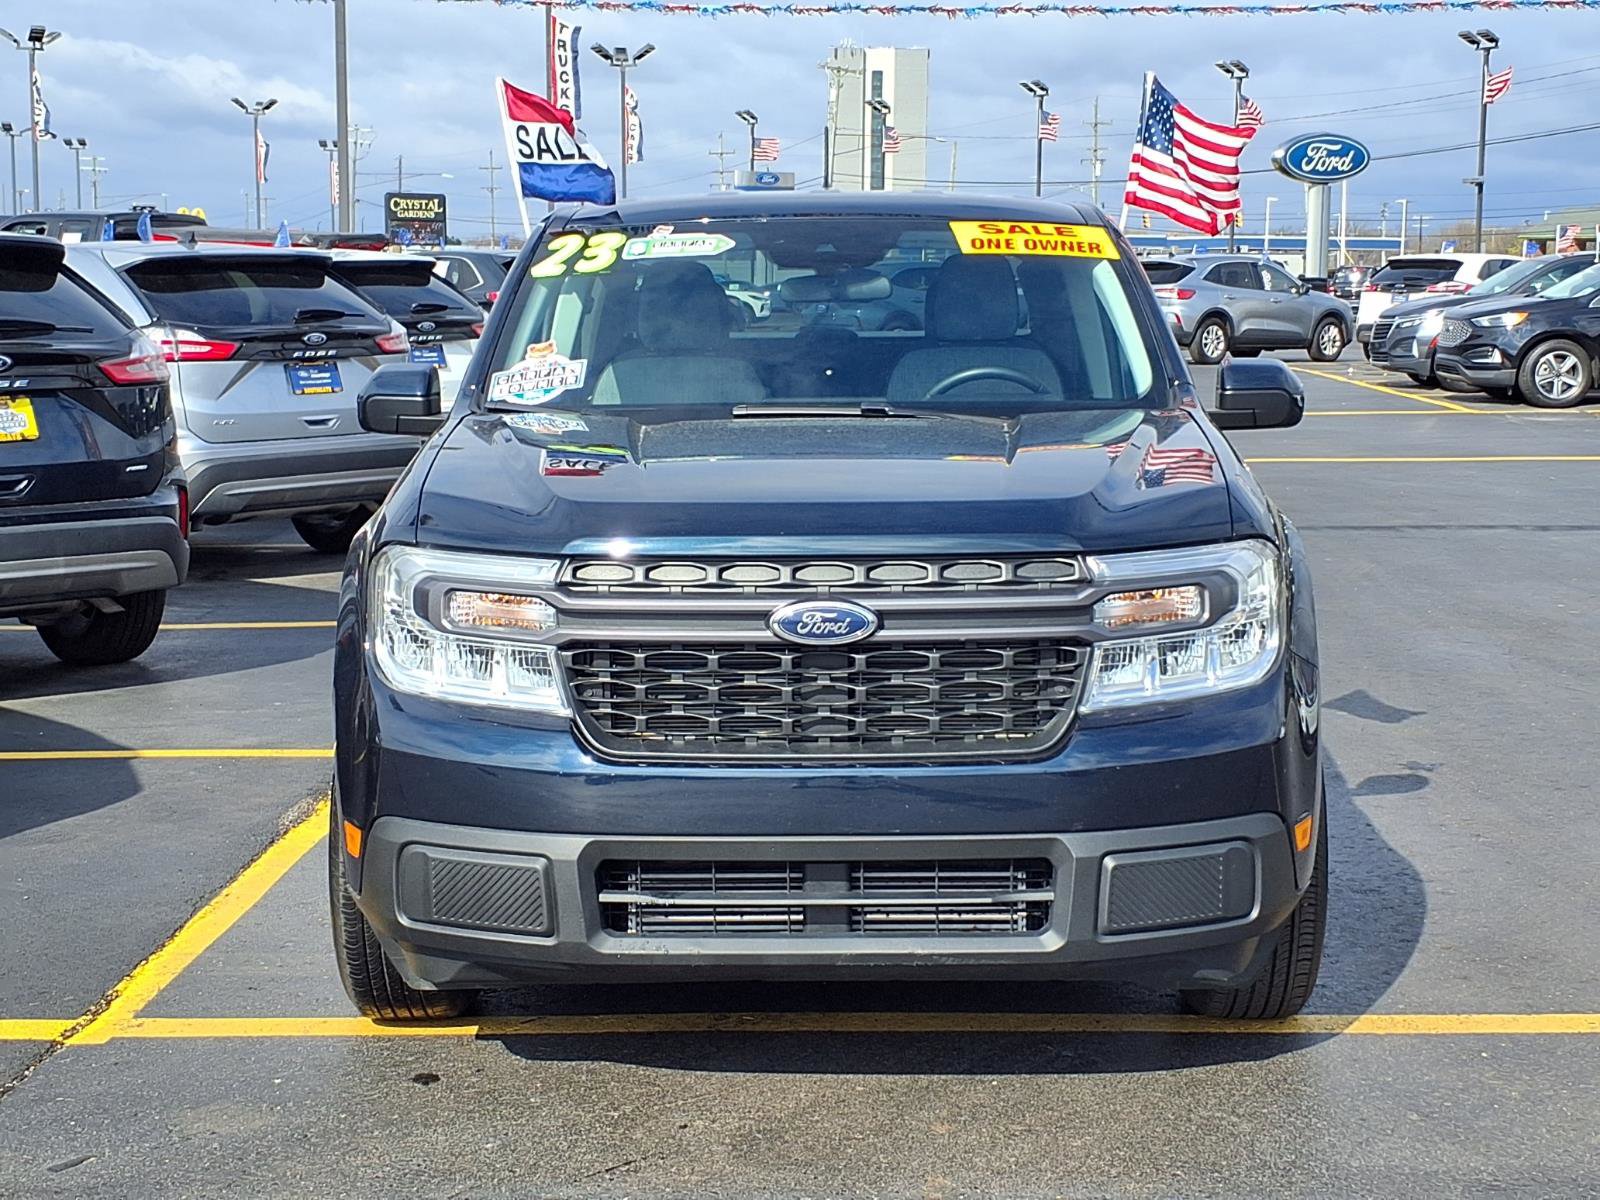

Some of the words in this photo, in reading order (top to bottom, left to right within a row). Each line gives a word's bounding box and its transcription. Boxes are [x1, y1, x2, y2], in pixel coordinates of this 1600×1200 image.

[1301, 143, 1355, 172] Ford
[390, 197, 444, 212] CRYSTAL
[397, 210, 435, 218] GARDENS
[977, 223, 1078, 238] SALE
[970, 238, 1015, 250] ONE
[1024, 238, 1102, 254] OWNER
[530, 232, 627, 277] 23
[797, 612, 851, 634] Ford
